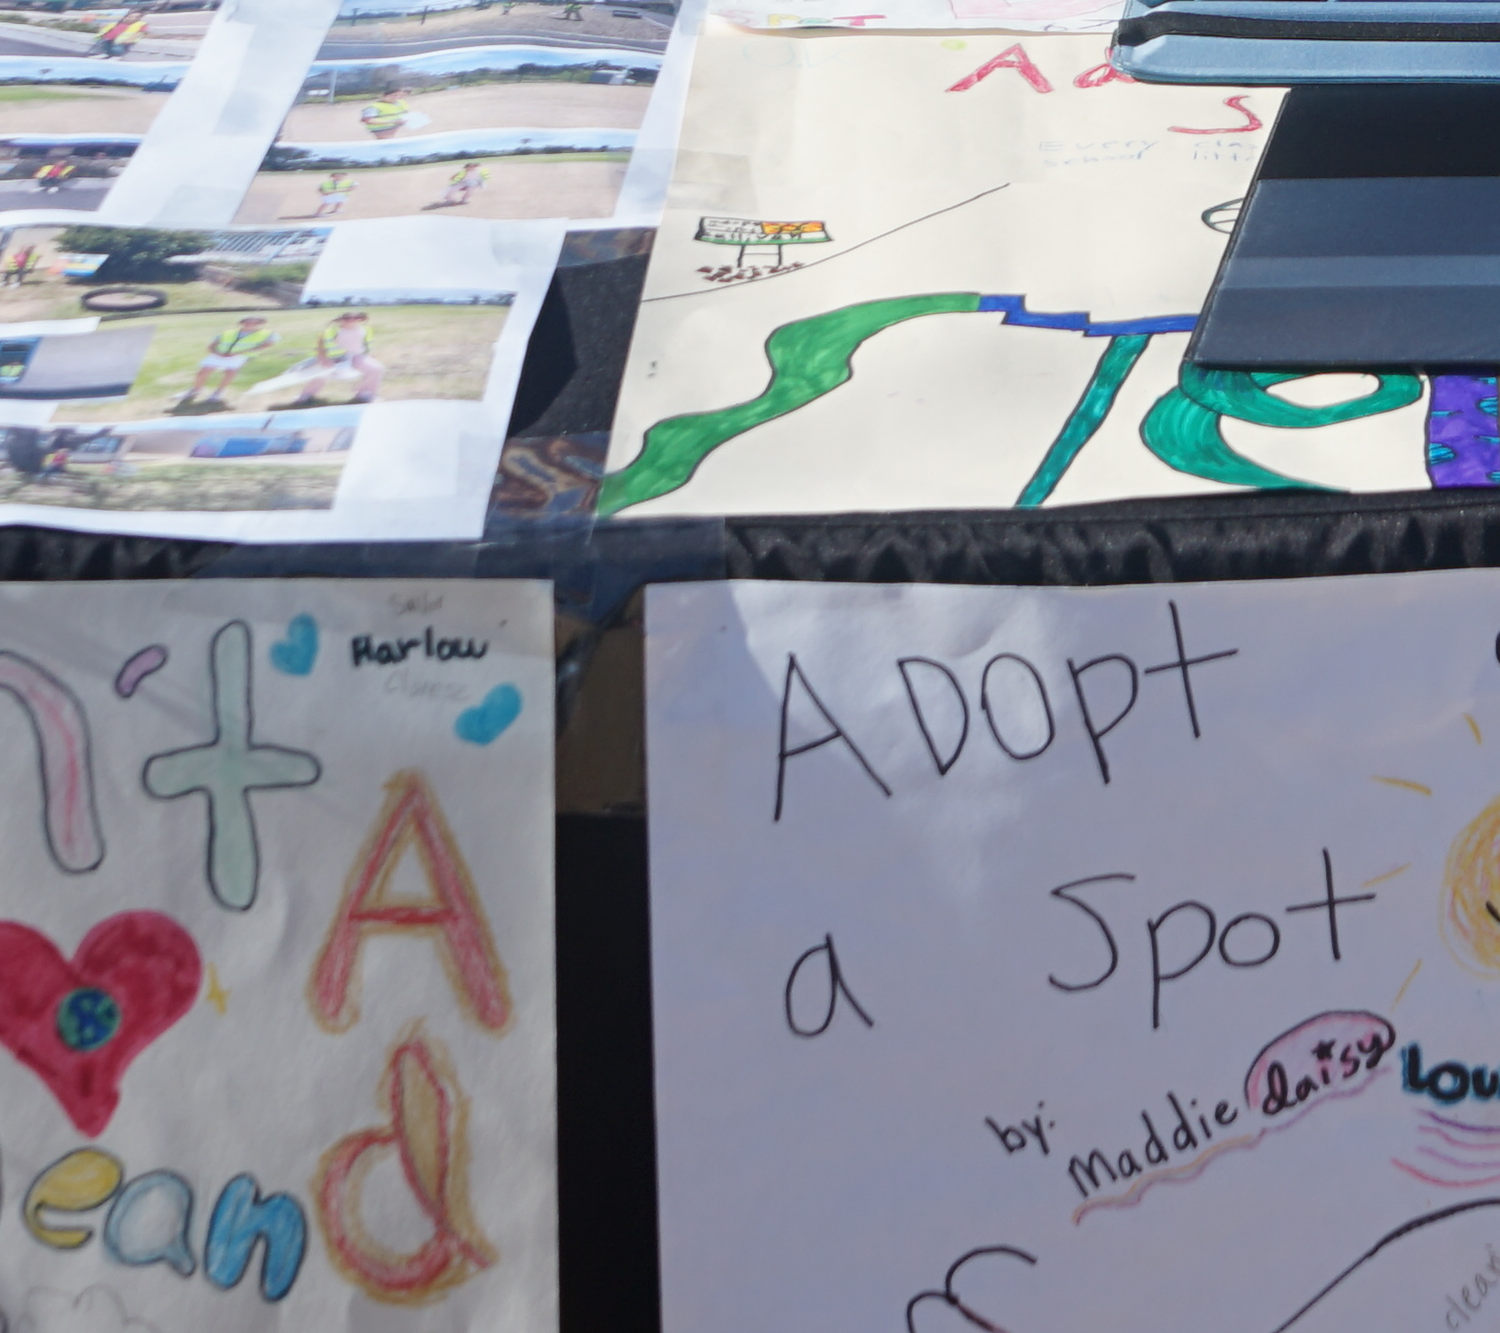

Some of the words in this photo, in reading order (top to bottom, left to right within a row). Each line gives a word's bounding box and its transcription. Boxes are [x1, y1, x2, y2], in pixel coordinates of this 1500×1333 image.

[351, 623, 490, 668] Harlow
[783, 933, 875, 1037] a
[1067, 1091, 1238, 1199] Maddie
